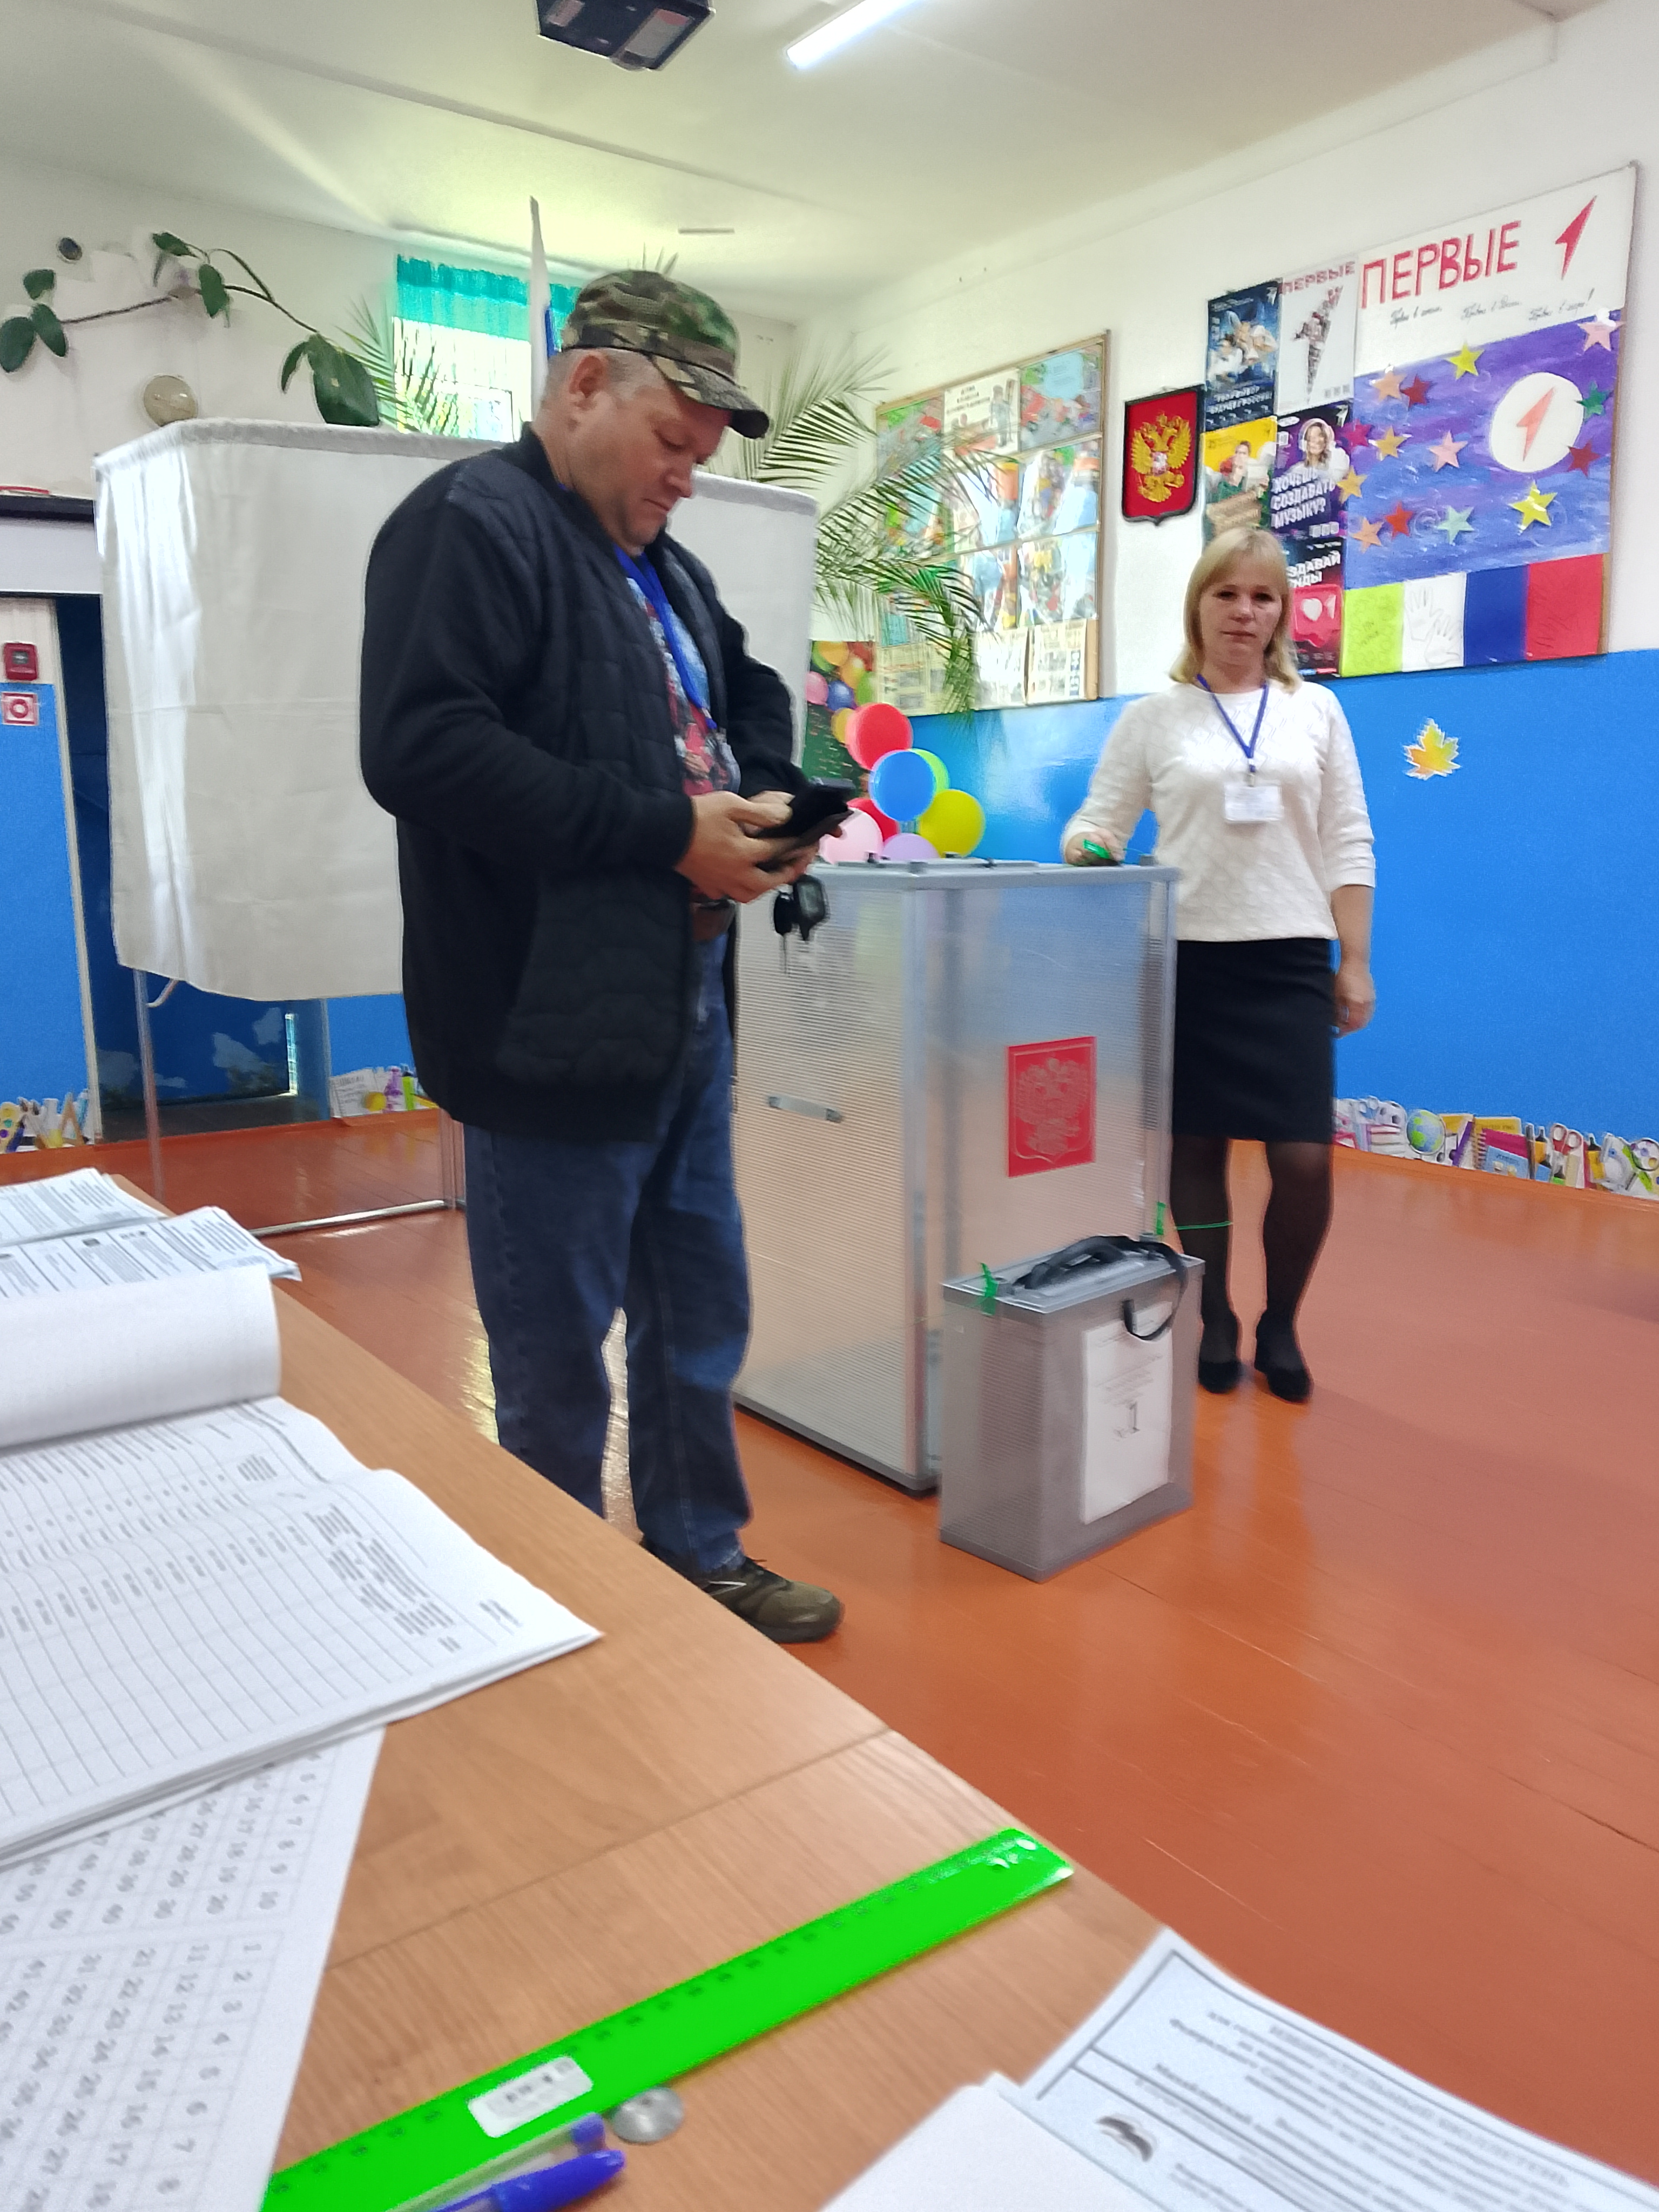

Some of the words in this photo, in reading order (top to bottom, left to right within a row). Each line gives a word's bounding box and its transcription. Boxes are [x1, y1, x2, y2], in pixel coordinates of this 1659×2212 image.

[1280, 261, 1355, 294] ПЕРВЫЕ
[1361, 220, 1521, 308] ПЕРВЫЕ
[1271, 480, 1337, 511] СОЗДАВАТЬ
[1272, 468, 1319, 494] ХОЧЕШЬ
[1271, 496, 1327, 529] МУЗЫКУ?
[1286, 550, 1341, 578] ЗДАВАЙ
